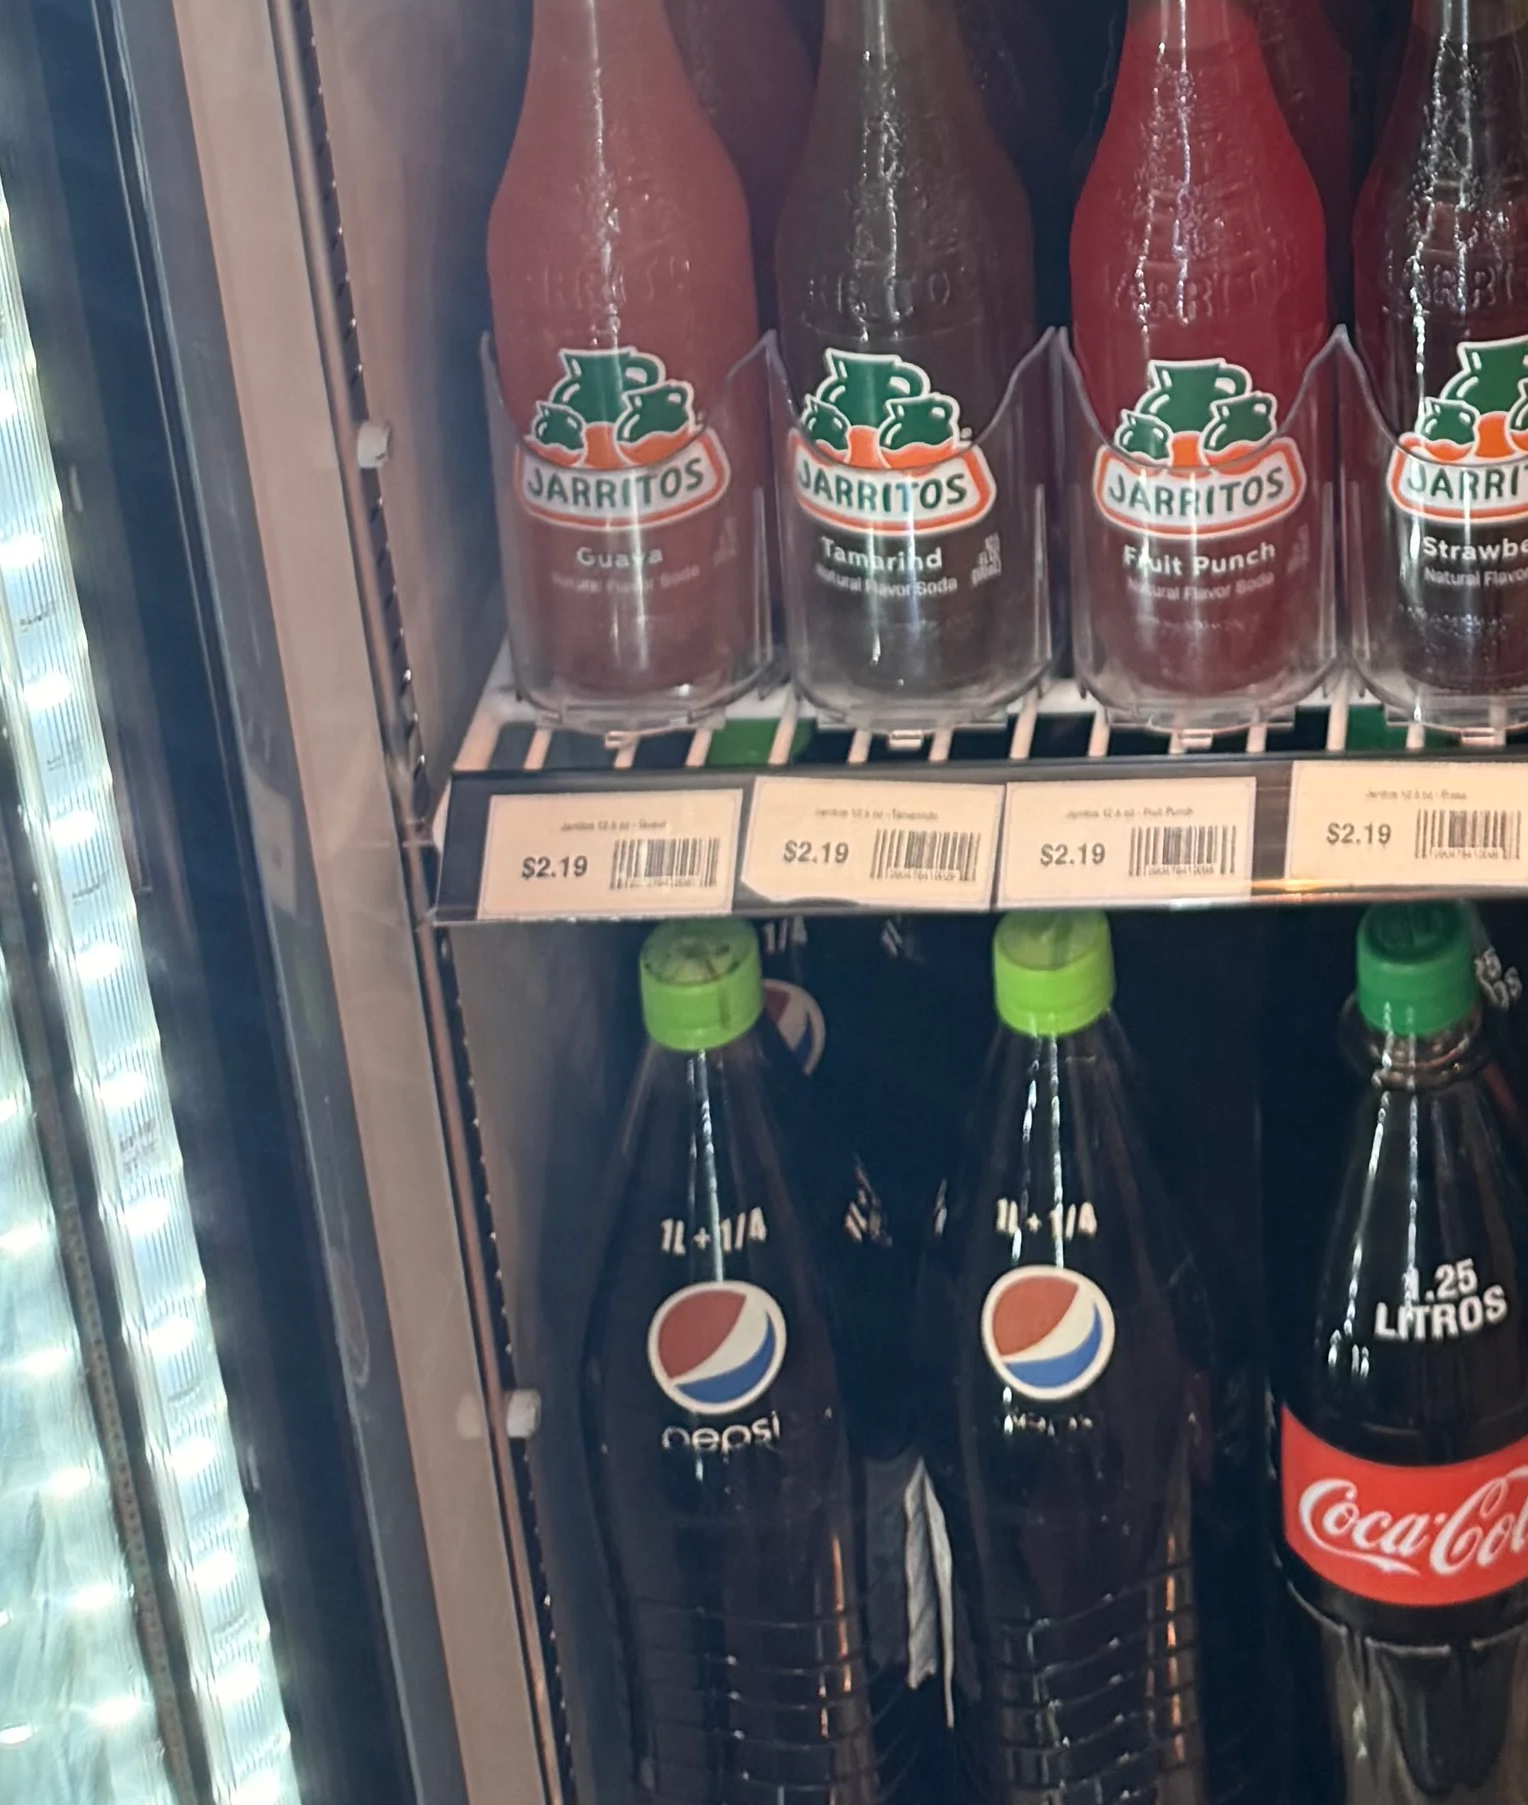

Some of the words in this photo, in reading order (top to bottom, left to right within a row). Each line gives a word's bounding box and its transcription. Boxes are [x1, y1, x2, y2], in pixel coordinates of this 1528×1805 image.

[527, 457, 704, 509] JARRITOS
[799, 460, 968, 513] JARRITOS
[1108, 466, 1284, 517] JARRITOS
[820, 536, 943, 572] Tamarind
[1122, 544, 1183, 577] Fruit
[1193, 542, 1276, 576] Punch
[1424, 567, 1480, 586] Natural
[783, 839, 850, 864] $2.19
[1325, 822, 1392, 847] $2.19
[521, 855, 588, 880] $2.19
[1039, 843, 1106, 868] $2.19
[1405, 1257, 1478, 1302] 1.25
[1374, 1284, 1507, 1341] LITROS
